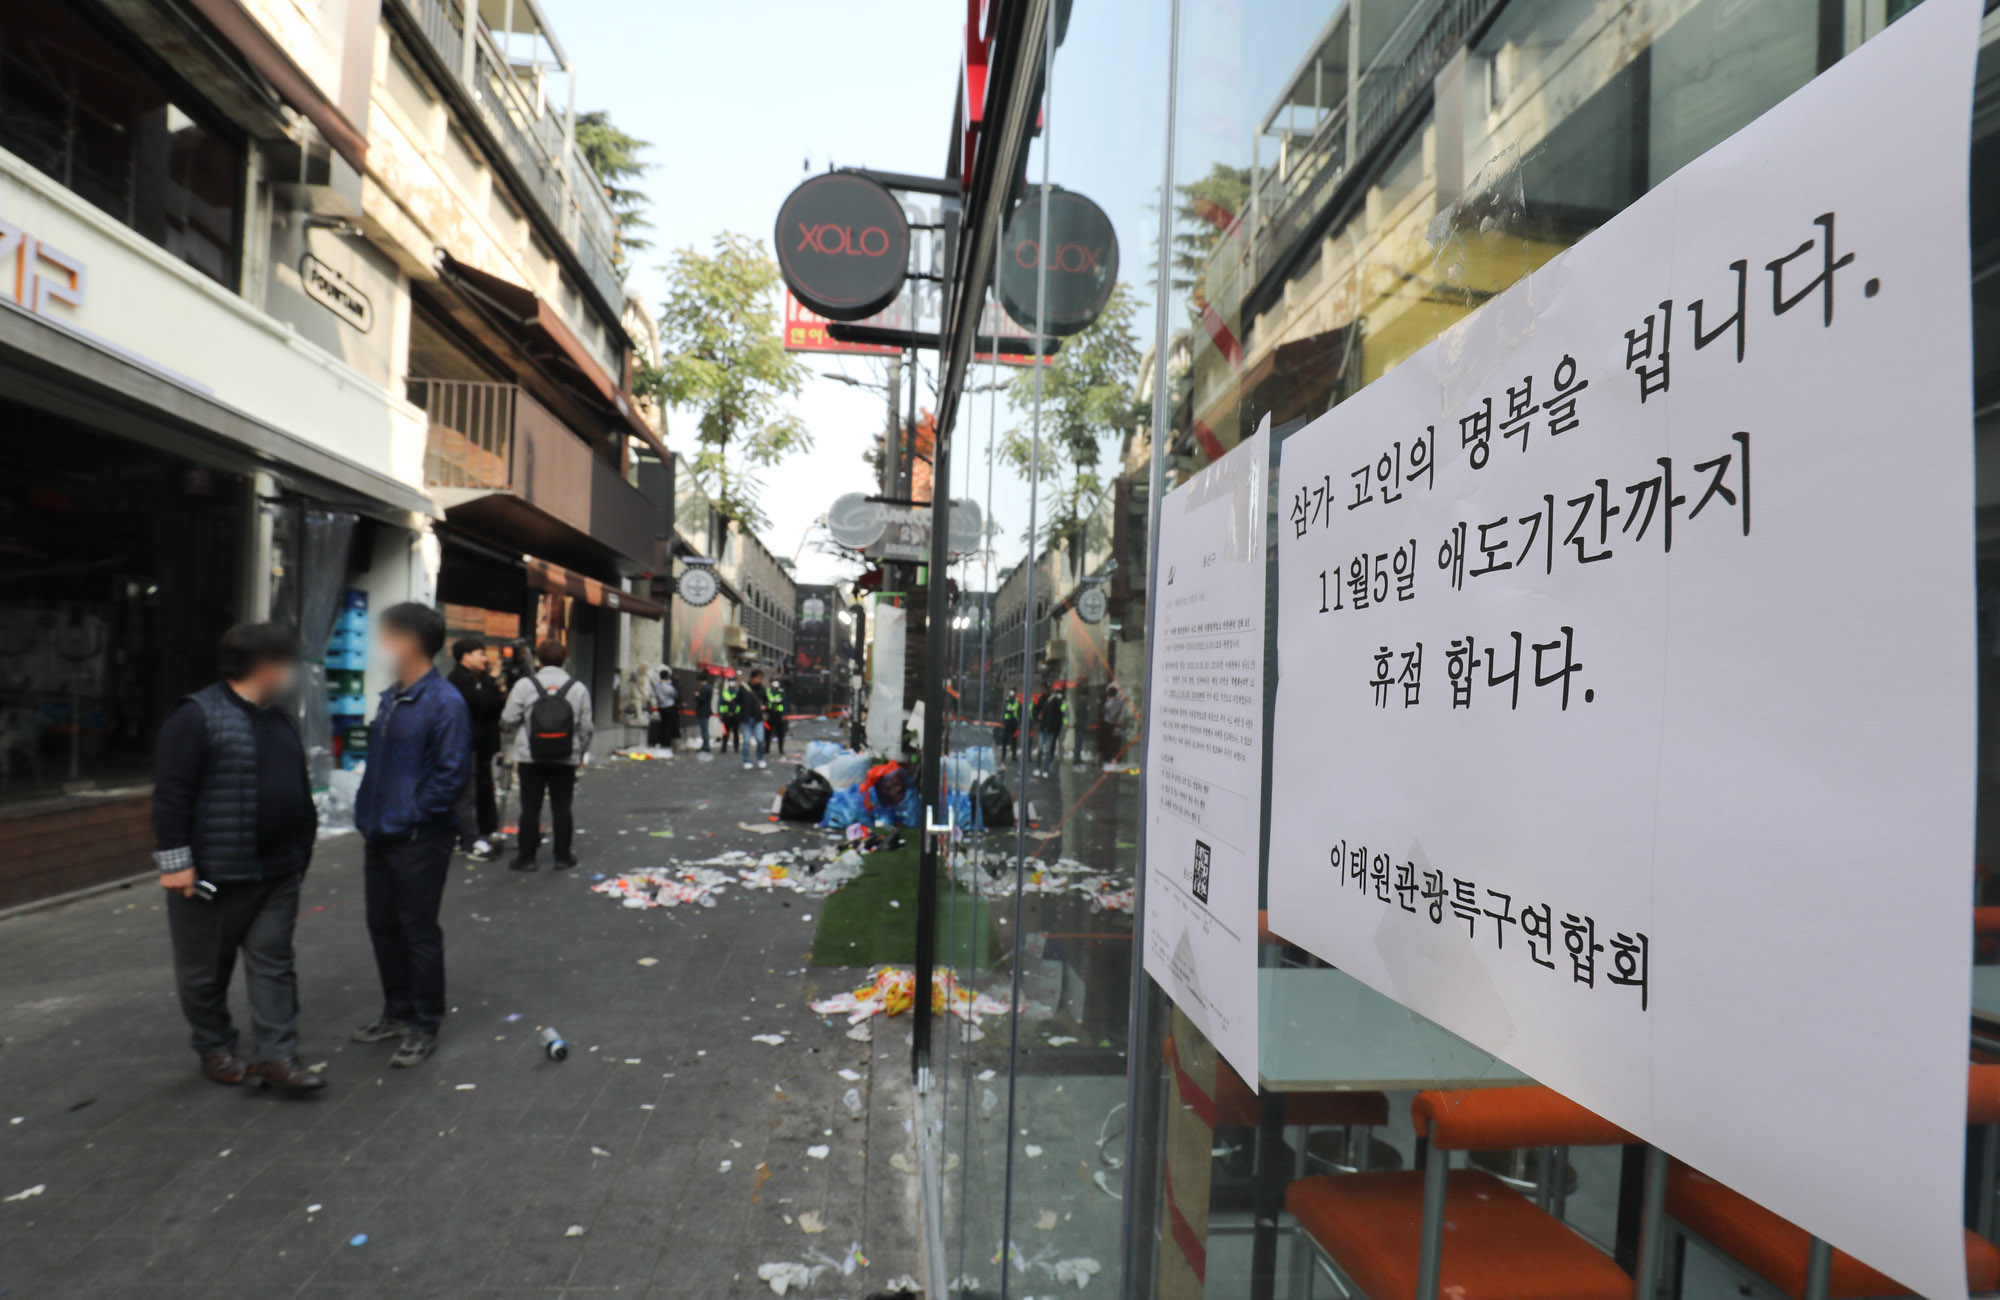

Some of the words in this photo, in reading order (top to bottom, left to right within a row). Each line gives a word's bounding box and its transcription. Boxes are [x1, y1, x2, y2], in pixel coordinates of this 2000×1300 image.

[797, 222, 890, 257] XOLO
[1290, 475, 1335, 540] 삼가
[1347, 425, 1436, 511] 고인의
[1460, 354, 1588, 470] 명복을
[1624, 212, 1881, 404] 빕니다.
[1319, 538, 1417, 614] 11월5일
[1437, 431, 1752, 592] 애도기간까지
[1369, 642, 1423, 709] 휴점
[1445, 625, 1595, 712] 합니다.
[1330, 839, 1649, 1012] 이태원관광특구연합회
